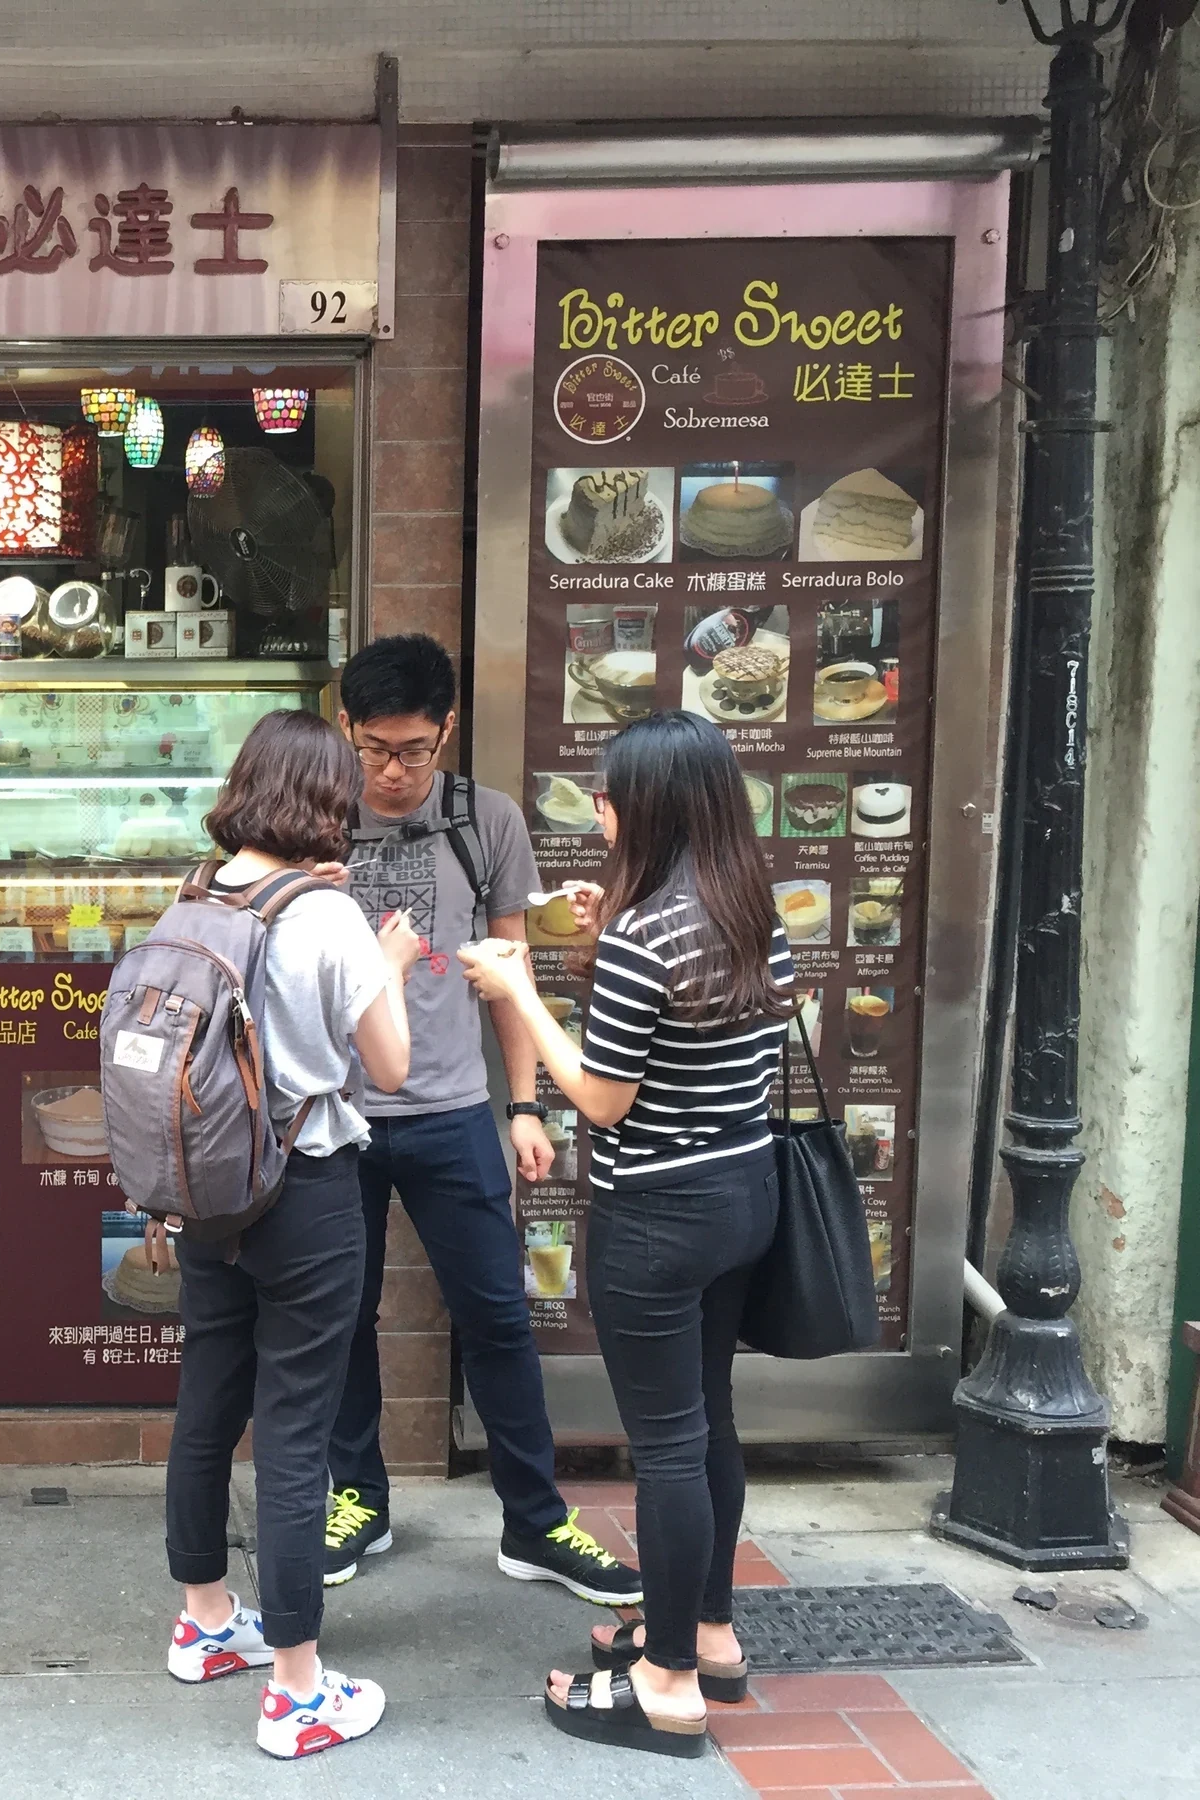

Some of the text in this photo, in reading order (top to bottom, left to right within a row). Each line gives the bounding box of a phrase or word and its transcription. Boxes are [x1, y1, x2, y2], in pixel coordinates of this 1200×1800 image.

[310, 290, 348, 324] 92
[558, 280, 904, 350] Bitter Sweet
[562, 360, 638, 394] Bitter Sweet
[651, 364, 701, 384] Café
[793, 361, 915, 402] 必達士
[569, 412, 629, 436] 必達士
[664, 407, 770, 428] Sobremesa
[549, 572, 675, 590] Serradura Cake
[687, 571, 767, 592] 木糠蛋糕
[782, 570, 904, 589] Serradura Bolo
[756, 741, 786, 753] Mocha
[806, 746, 903, 759] Supreme Blue Mountain
[355, 842, 437, 862] THINK
[570, 848, 608, 859] Pudding
[854, 853, 910, 864] Coffee Pudding
[351, 857, 437, 872] OUTSIDE
[572, 858, 602, 867] Pudim
[794, 860, 831, 870] Tiramisu
[351, 867, 437, 883] THE BOX
[812, 961, 840, 969] Pudding
[804, 971, 827, 979] Manga
[856, 968, 889, 977] Affogato
[63, 1020, 99, 1040] Café
[849, 1076, 893, 1085] Ice Lemon Tea
[39, 1169, 67, 1186] 木糠
[73, 1169, 100, 1186] 布甸
[532, 1198, 569, 1206] Blueberry
[867, 1198, 887, 1206] Cow
[522, 1209, 541, 1217] Latte
[569, 1208, 584, 1216] Frio
[865, 1209, 888, 1217] Preta
[555, 1311, 568, 1319] QQ
[529, 1320, 568, 1329] QQ Manga
[82, 1348, 97, 1365] 有
